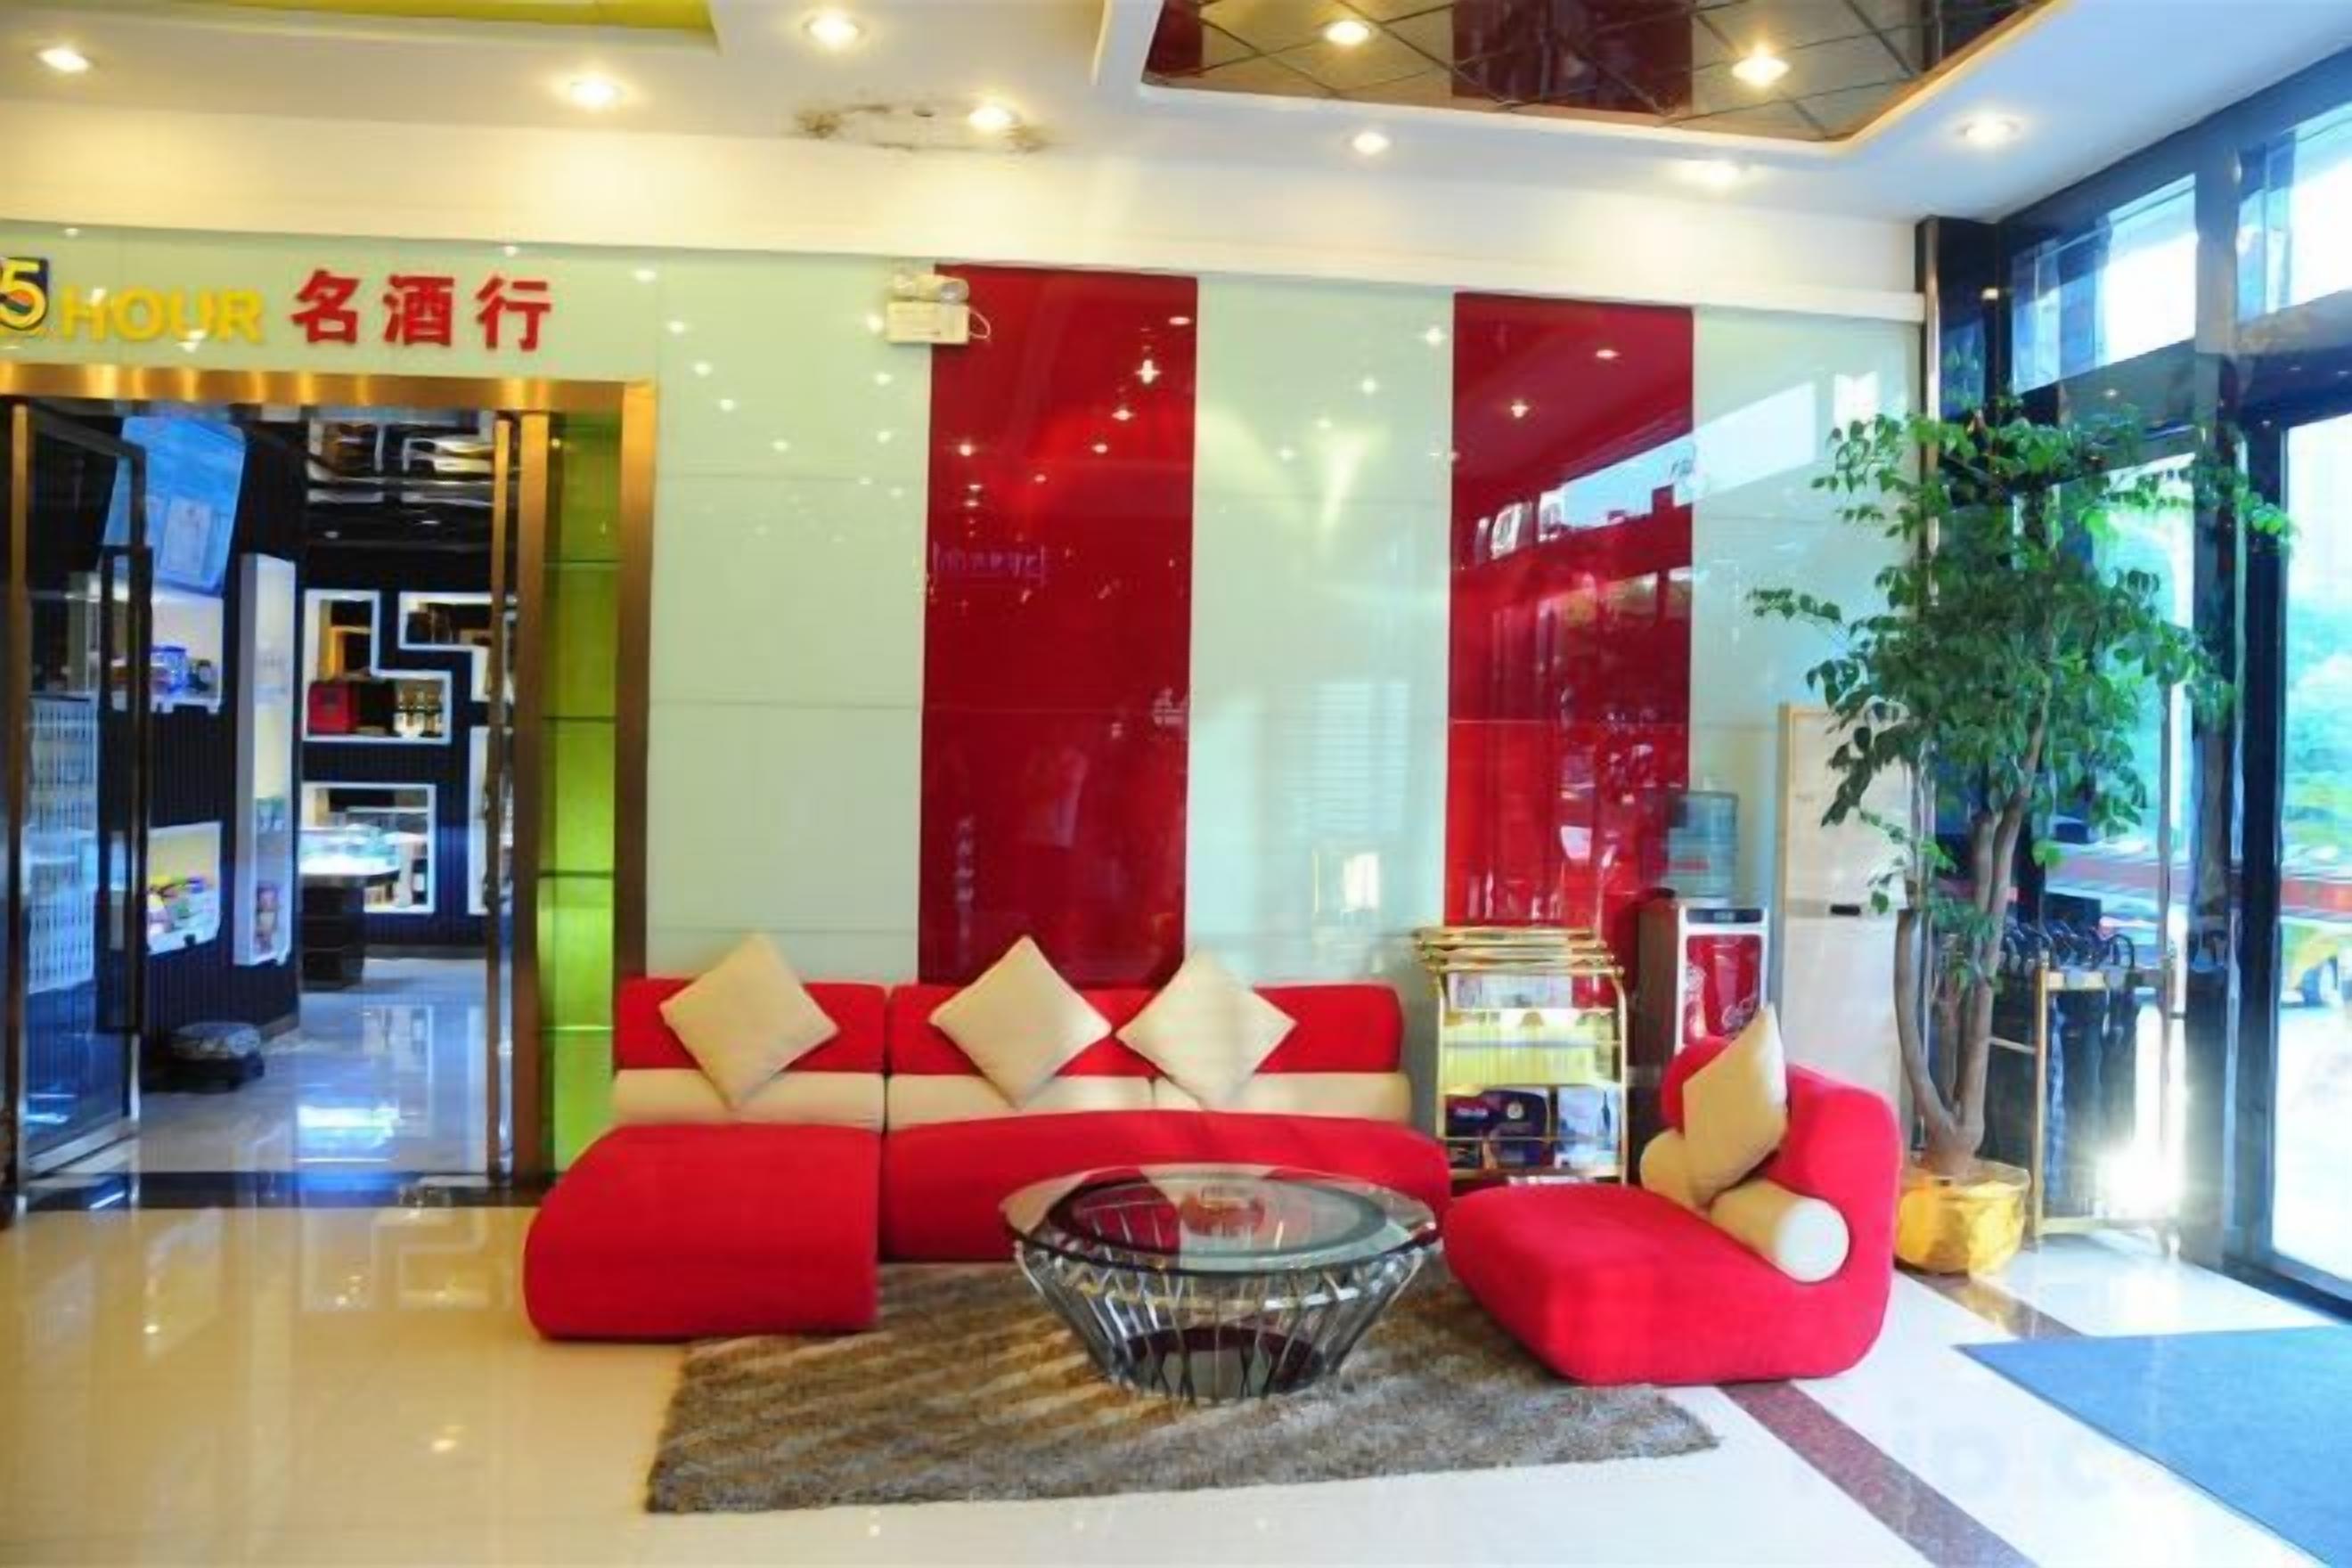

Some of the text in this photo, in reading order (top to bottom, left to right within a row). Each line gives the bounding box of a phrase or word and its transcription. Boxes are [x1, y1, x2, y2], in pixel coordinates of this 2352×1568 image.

[60, 285, 265, 342] HOUR
[291, 270, 552, 351] 名酒行
